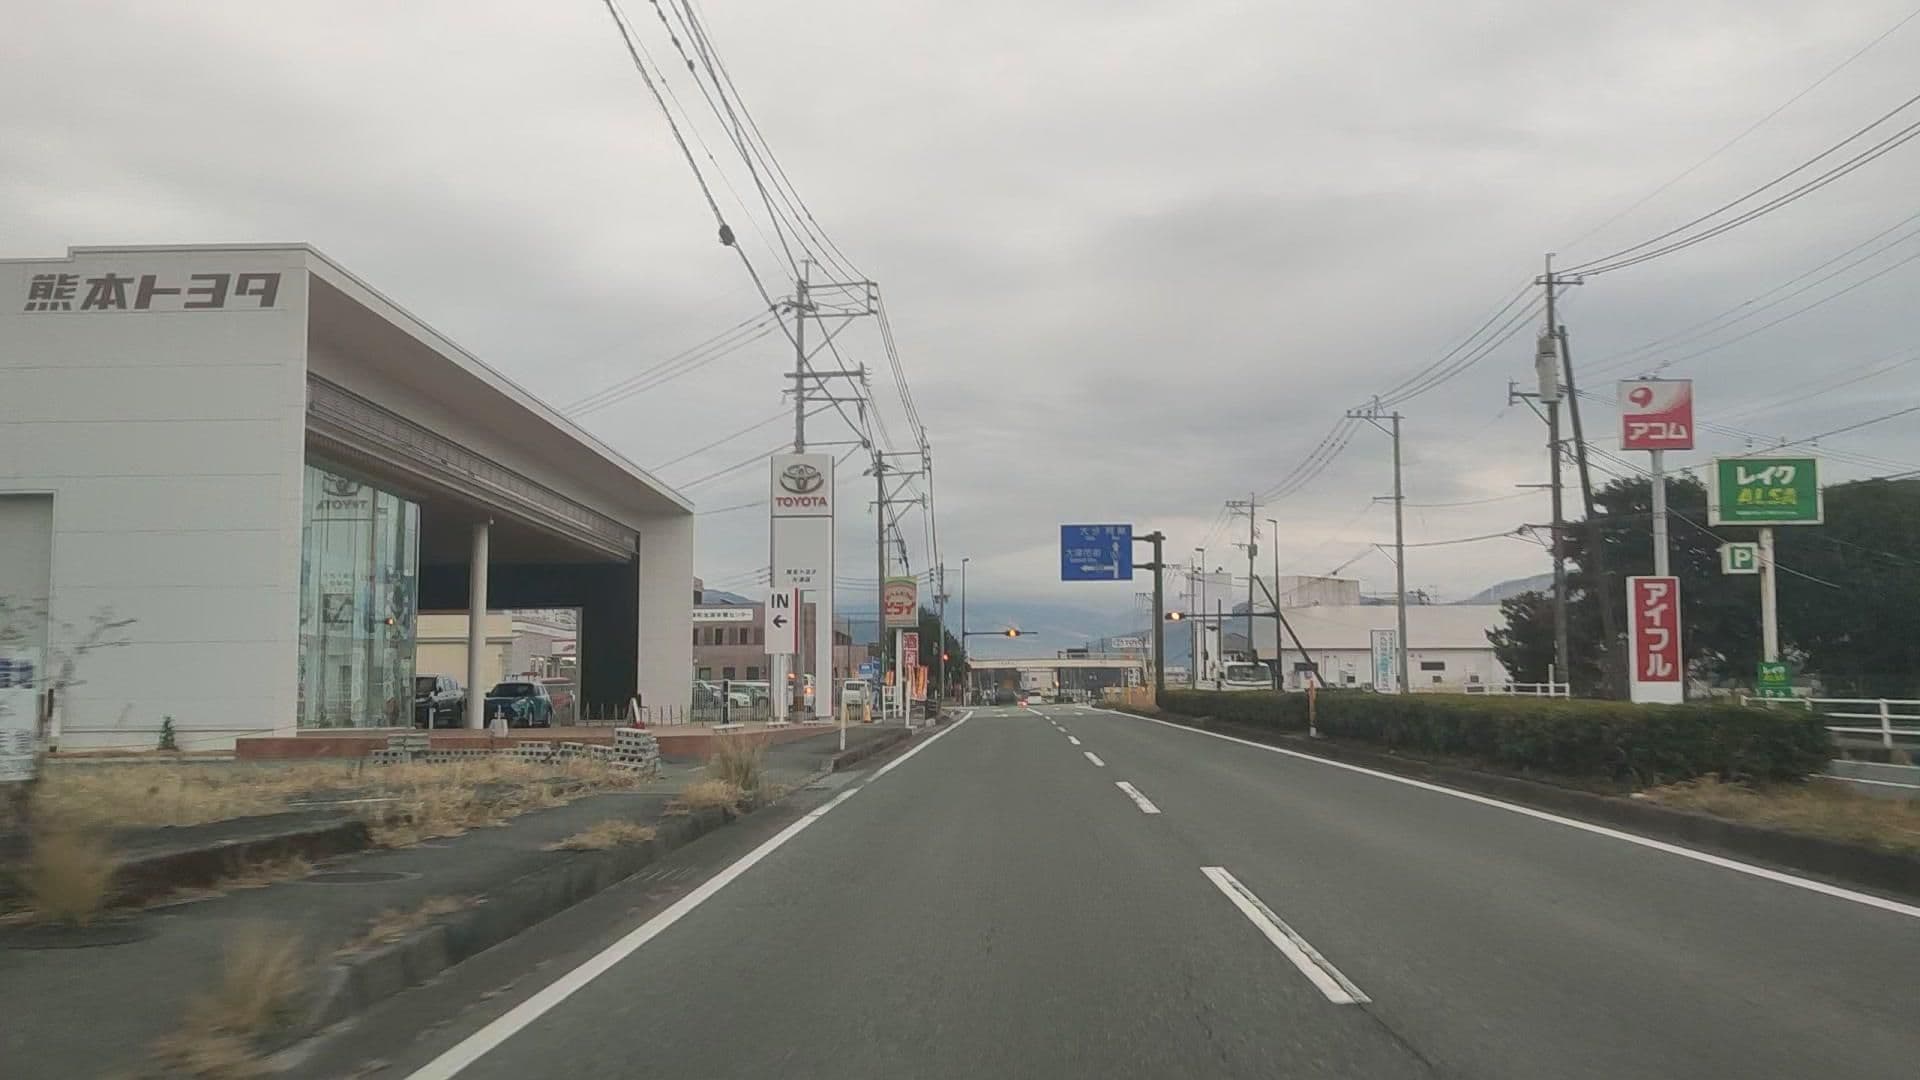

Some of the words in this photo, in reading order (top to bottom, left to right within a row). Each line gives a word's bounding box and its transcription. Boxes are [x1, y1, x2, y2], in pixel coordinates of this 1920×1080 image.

[24, 272, 281, 311] 熊本トヨタ
[1629, 422, 1687, 440] アコム
[1736, 465, 1796, 485] レイク
[776, 496, 827, 507] TOYOTA
[1737, 487, 1797, 504] ALSA
[1735, 551, 1750, 568] P
[771, 594, 789, 608] IN
[1643, 583, 1671, 676] アイフル
